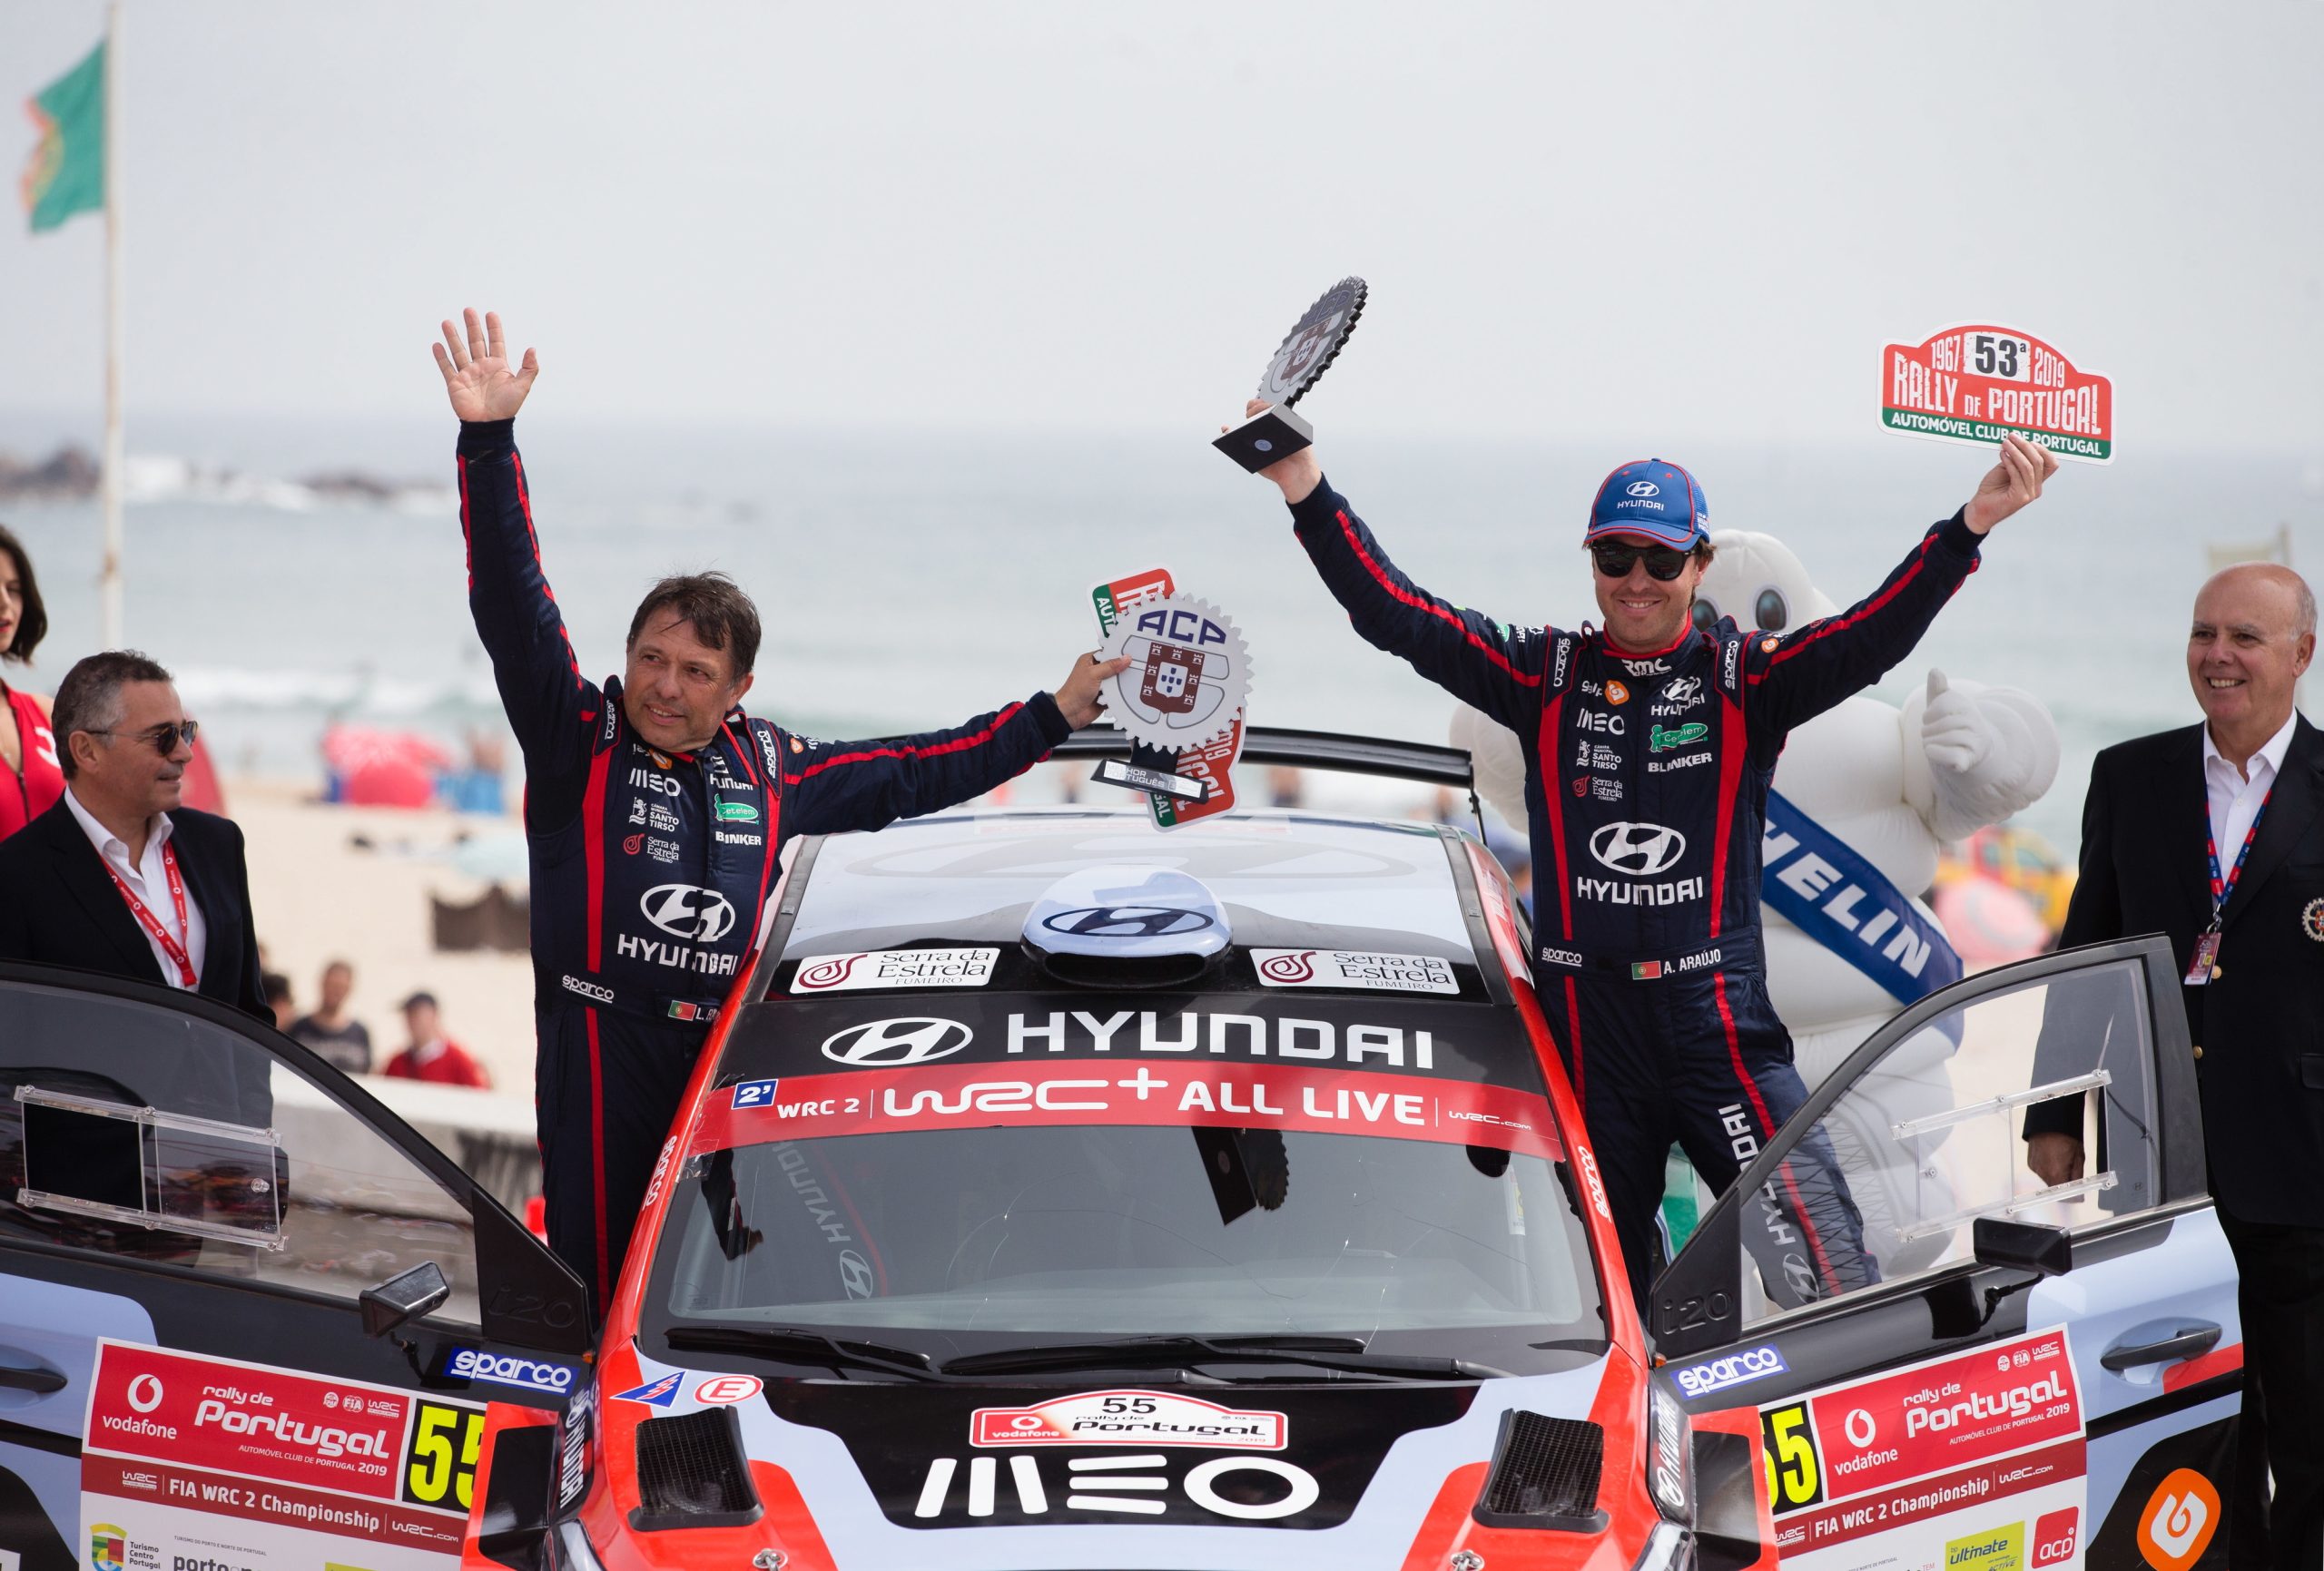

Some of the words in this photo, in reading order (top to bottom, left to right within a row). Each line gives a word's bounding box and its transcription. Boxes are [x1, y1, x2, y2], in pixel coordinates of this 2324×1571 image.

[1931, 335, 1961, 372] 1967
[2034, 348, 2065, 388] 2019
[1893, 351, 1958, 414] RALLY
[1965, 395, 1981, 417] DE
[1988, 384, 2102, 435] PORTUGAL
[1891, 412, 1972, 437] AUTOMÓVEL
[1974, 424, 2009, 441] CLUB
[2033, 433, 2102, 456] PORTUGAL
[1617, 499, 1664, 511] HYUNDAI
[1137, 610, 1226, 645] ACP
[1553, 638, 1571, 687] sparco
[1725, 640, 1738, 690] sparco
[1577, 708, 1625, 735] MEO
[1591, 761, 1618, 771] TIRSO
[1592, 753, 1622, 763] SANTO
[1648, 752, 1712, 772] BLINKER
[629, 768, 681, 797] MEO
[1591, 777, 1612, 788] Serra
[1613, 780, 1622, 789] da
[1592, 786, 1623, 799] Estrela
[649, 811, 679, 826] SANTO
[649, 820, 675, 832] TIRSO
[646, 845, 680, 860] Estrela
[647, 836, 669, 849] Serra
[670, 841, 680, 851] da
[1577, 876, 1703, 906] HYUNDAI
[1764, 818, 1932, 978] HELIN
[881, 952, 951, 964] Serra
[959, 949, 990, 961] da
[1333, 952, 1406, 967] Serra
[1406, 957, 1444, 969] da
[1541, 947, 1582, 967] sparco
[1663, 960, 1676, 975] A.
[1679, 948, 1721, 972] ARAÚJO
[876, 960, 987, 978] Estrela
[1339, 964, 1452, 984] Estrela
[562, 974, 615, 1004] sparco
[895, 977, 962, 985] FUMEIRO
[1366, 980, 1433, 990] FUMEIRO
[1008, 1011, 1433, 1069] HYUNDAI
[777, 1099, 835, 1119] WRC
[844, 1098, 860, 1113] 2
[1177, 1080, 1284, 1115] ALL
[1303, 1086, 1425, 1125] LIVE
[642, 1134, 678, 1211] sparco
[1578, 1145, 1611, 1223] sparco
[2032, 1341, 2060, 1355] WRC
[450, 1350, 573, 1394] sparco
[1678, 1348, 1784, 1397] sparco
[202, 1386, 247, 1404] rally
[250, 1391, 274, 1407] de
[710, 1380, 746, 1399] E
[1903, 1388, 1940, 1408] rally
[1942, 1382, 1962, 1396] de
[368, 1399, 400, 1412] WRC
[1101, 1398, 1157, 1414] 55
[1906, 1370, 2068, 1438] Portugal
[103, 1415, 177, 1440] vodafone
[193, 1399, 390, 1458] Portugal
[992, 1429, 1060, 1438] vodafone
[1072, 1421, 1265, 1436] Portugal
[1949, 1430, 1986, 1445] AUTOMÓVEL
[1986, 1425, 2003, 1436] CLUB
[2003, 1422, 2012, 1431] DE
[2012, 1413, 2045, 1429] PORTUGAL
[2046, 1402, 2071, 1419] 2019
[239, 1444, 283, 1458] AUTOMÓVEL
[284, 1452, 303, 1462] CLUB
[304, 1456, 314, 1464] DE
[315, 1458, 356, 1471] PORTUGAL
[358, 1462, 388, 1477] 2019
[1834, 1448, 1898, 1477] vodafone
[123, 1470, 157, 1484] WRC
[914, 1454, 1319, 1520] MEO
[170, 1478, 197, 1498] FIA
[202, 1484, 240, 1506] WRC
[244, 1491, 255, 1508] 2
[261, 1494, 379, 1533] Championship
[1815, 1517, 1839, 1538] FIA
[1842, 1507, 1875, 1530] WRC
[1877, 1503, 1888, 1521] 2
[1891, 1477, 1990, 1517] Championship
[174, 1535, 194, 1544] TURISMO
[1775, 1526, 1805, 1541] WRC
[129, 1549, 154, 1560] Centro
[130, 1541, 160, 1553] Turismo
[1950, 1539, 2008, 1565] ultimate
[2039, 1537, 2073, 1560] acp
[129, 1557, 161, 1569] Portugal
